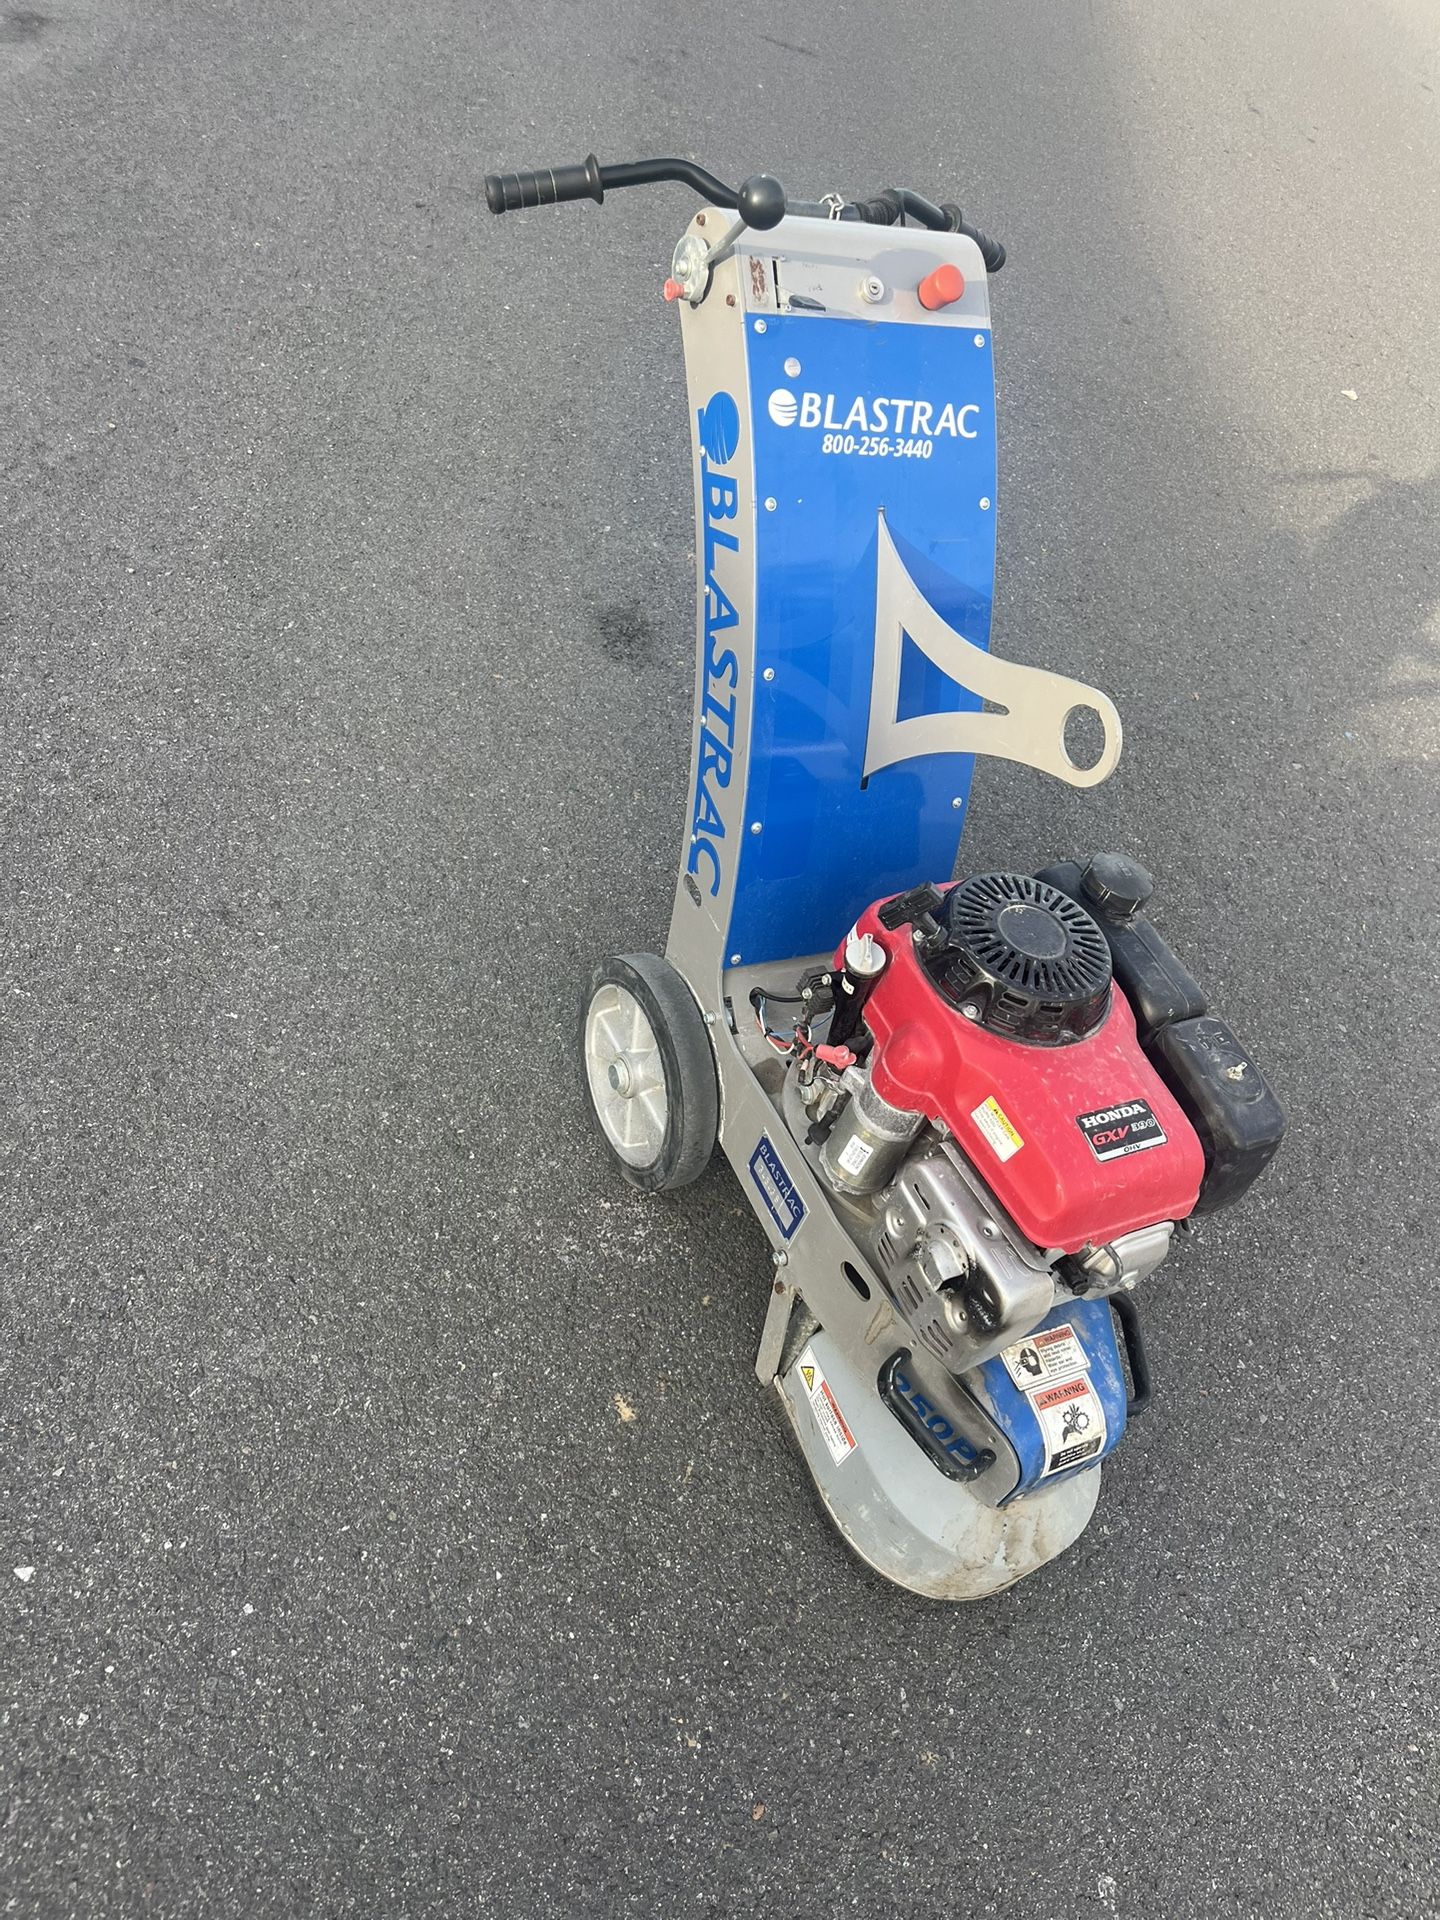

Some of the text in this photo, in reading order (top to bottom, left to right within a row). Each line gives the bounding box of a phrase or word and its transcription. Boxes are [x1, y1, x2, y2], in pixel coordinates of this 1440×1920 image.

[799, 392, 979, 439] BLASTRAC
[822, 434, 933, 459] 800-256-3440
[690, 472, 740, 896] BLASTRAC
[997, 1113, 1014, 1136] CAUTION
[1080, 1103, 1146, 1128] HONDA
[1091, 1124, 1128, 1146] GXV
[1123, 1143, 1140, 1152] OHV
[759, 1143, 801, 1217] BLASTRAC
[1044, 1329, 1070, 1342] WARNING
[1046, 1384, 1085, 1403] WARNING
